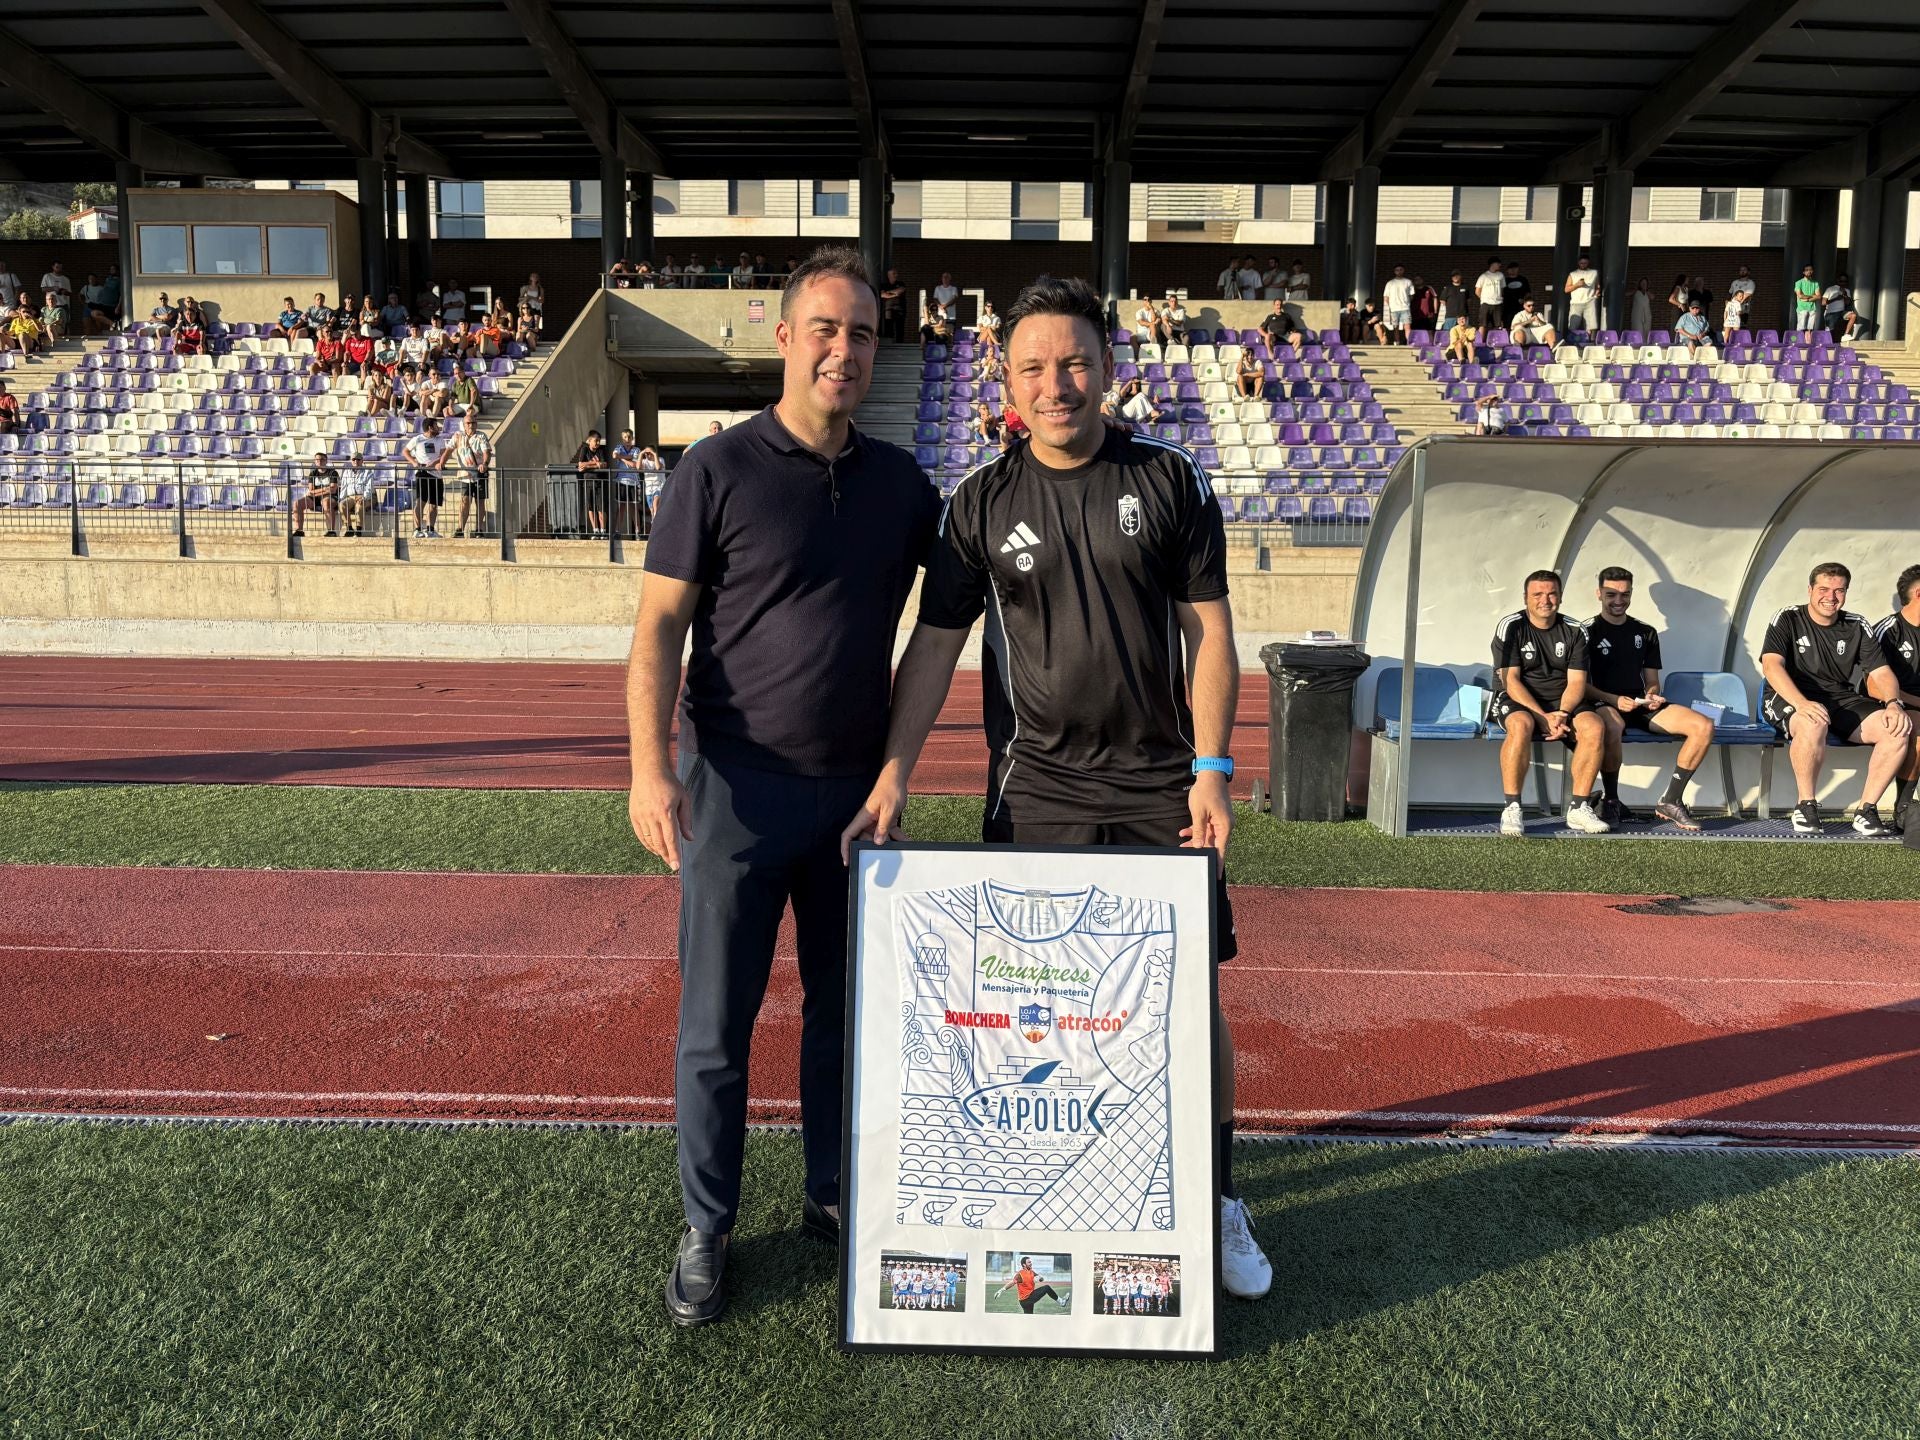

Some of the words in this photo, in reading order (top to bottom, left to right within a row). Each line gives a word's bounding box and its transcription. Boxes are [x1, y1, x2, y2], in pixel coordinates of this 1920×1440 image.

[1018, 556, 1032, 568] RA
[980, 955, 1092, 986] Viruxpress
[982, 983, 1032, 994] Mensajería
[1033, 987, 1039, 996] y
[1041, 986, 1089, 997] Paquetería
[945, 1010, 1011, 1029] BONACHERA
[1058, 1010, 1122, 1032] atracón
[997, 1096, 1082, 1133] APOLO
[1030, 1136, 1057, 1147] desde
[1060, 1137, 1082, 1148] 1963
